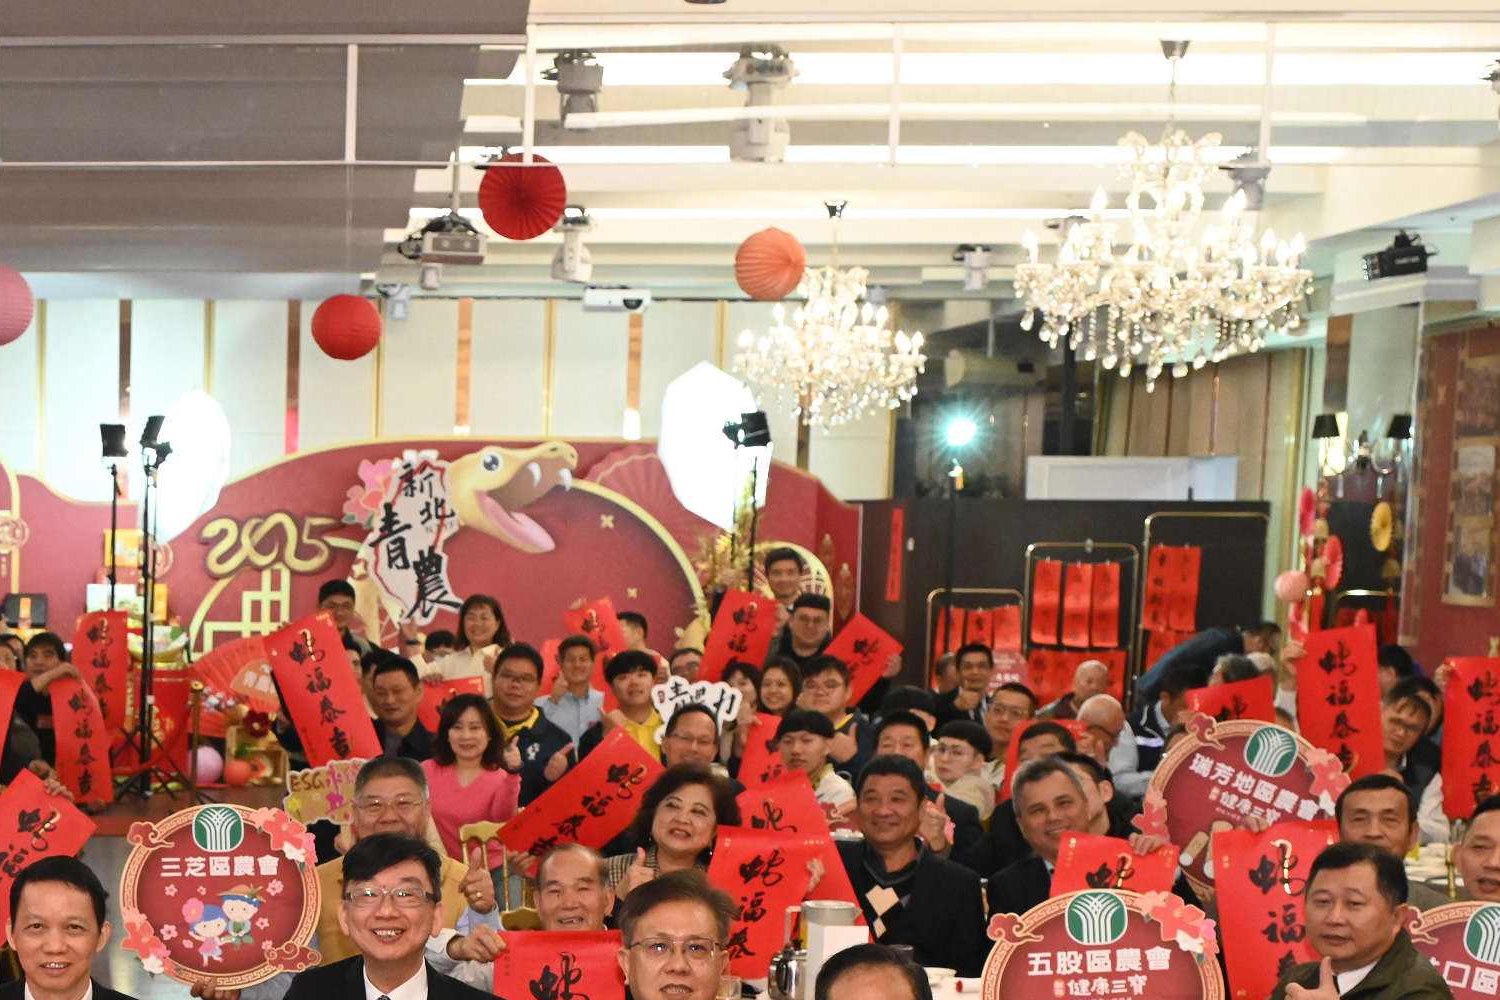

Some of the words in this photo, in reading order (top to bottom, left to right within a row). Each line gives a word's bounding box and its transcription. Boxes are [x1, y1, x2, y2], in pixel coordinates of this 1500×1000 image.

[290, 771, 325, 792] ESG
[1189, 752, 1319, 821] 瑞芳地區農會
[160, 855, 279, 877] 三芝區農會
[1028, 946, 1172, 976] 五股區農會
[1067, 973, 1148, 996] 健康三寶
